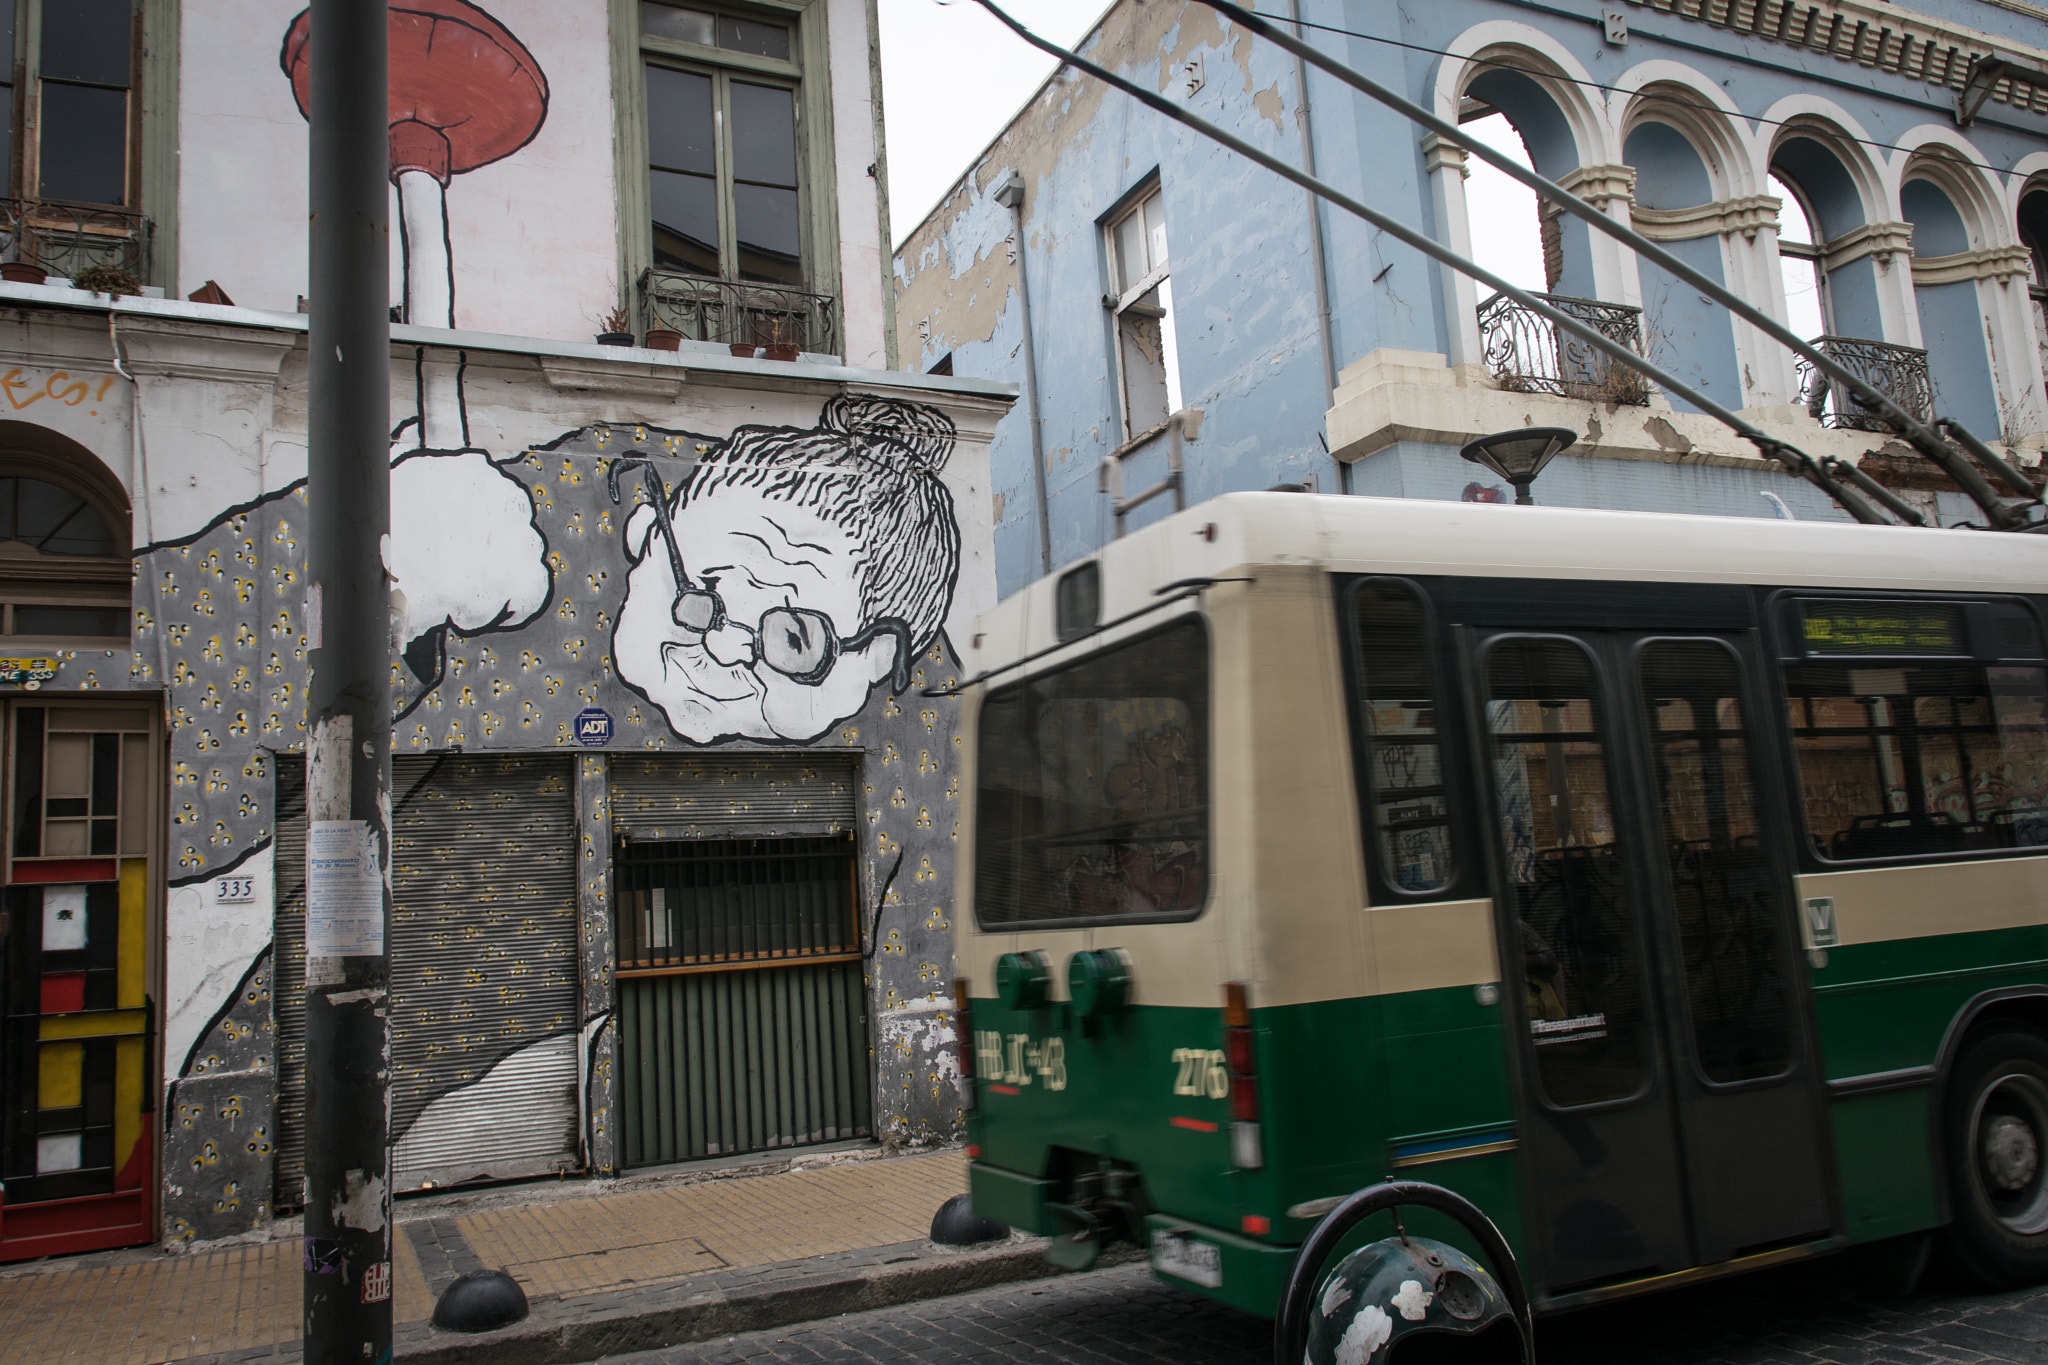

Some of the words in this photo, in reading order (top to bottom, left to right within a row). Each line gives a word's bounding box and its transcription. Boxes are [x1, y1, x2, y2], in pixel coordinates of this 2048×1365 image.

[28, 668, 54, 680] 333
[581, 721, 608, 734] ADT
[218, 880, 252, 897] 335
[1171, 1048, 1229, 1099] 276
